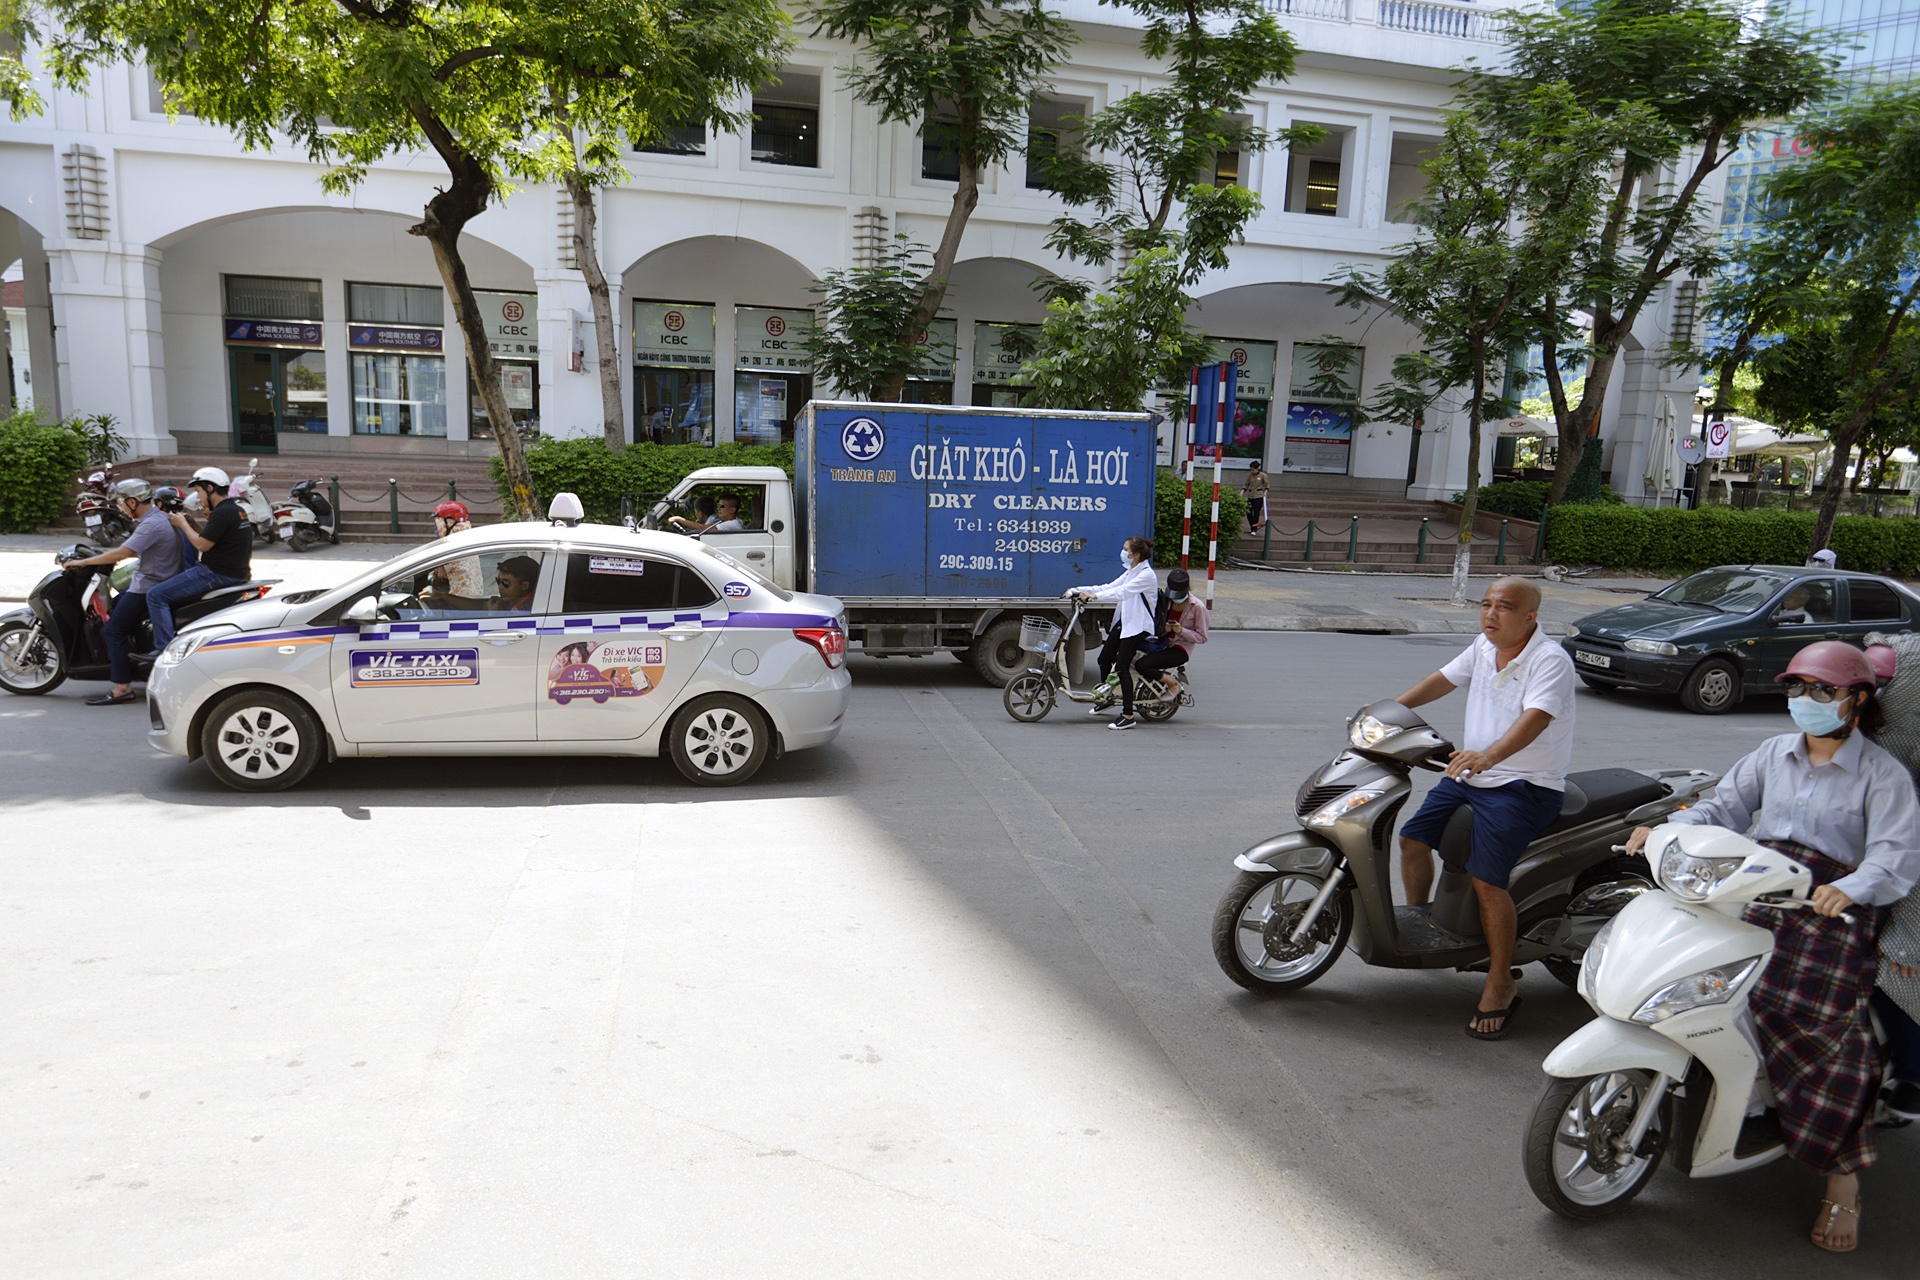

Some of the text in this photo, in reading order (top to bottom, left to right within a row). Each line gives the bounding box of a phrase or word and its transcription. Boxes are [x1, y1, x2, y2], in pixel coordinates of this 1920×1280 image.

[256, 325, 300, 335] 中国南方航空
[499, 325, 528, 336] ICBC
[378, 331, 421, 341] 中国南方航空
[661, 334, 688, 345] ICBC
[395, 338, 422, 346] SOUTHERN
[761, 339, 788, 350] ICBC
[687, 355, 700, 364] TRUNG
[997, 354, 1022, 365] ICBC
[910, 436, 970, 489] GIẶT
[973, 437, 1026, 483] KHÔ
[1049, 439, 1079, 484] LÀ
[1086, 446, 1129, 486] HƠI
[830, 466, 897, 483] TRÀNG AN
[929, 493, 1107, 512] DRY CLEANERS
[996, 519, 1071, 534] 6341939
[994, 538, 1073, 554] 2408867
[725, 585, 749, 596] 357
[603, 647, 614, 656] Đi
[627, 646, 643, 656] VIC
[410, 654, 460, 667] TAXI
[372, 668, 458, 678] 38.230.230
[559, 688, 605, 696] 38.230.230
[1672, 906, 1699, 919] HONDA
[1686, 1026, 1725, 1039] HONDA
